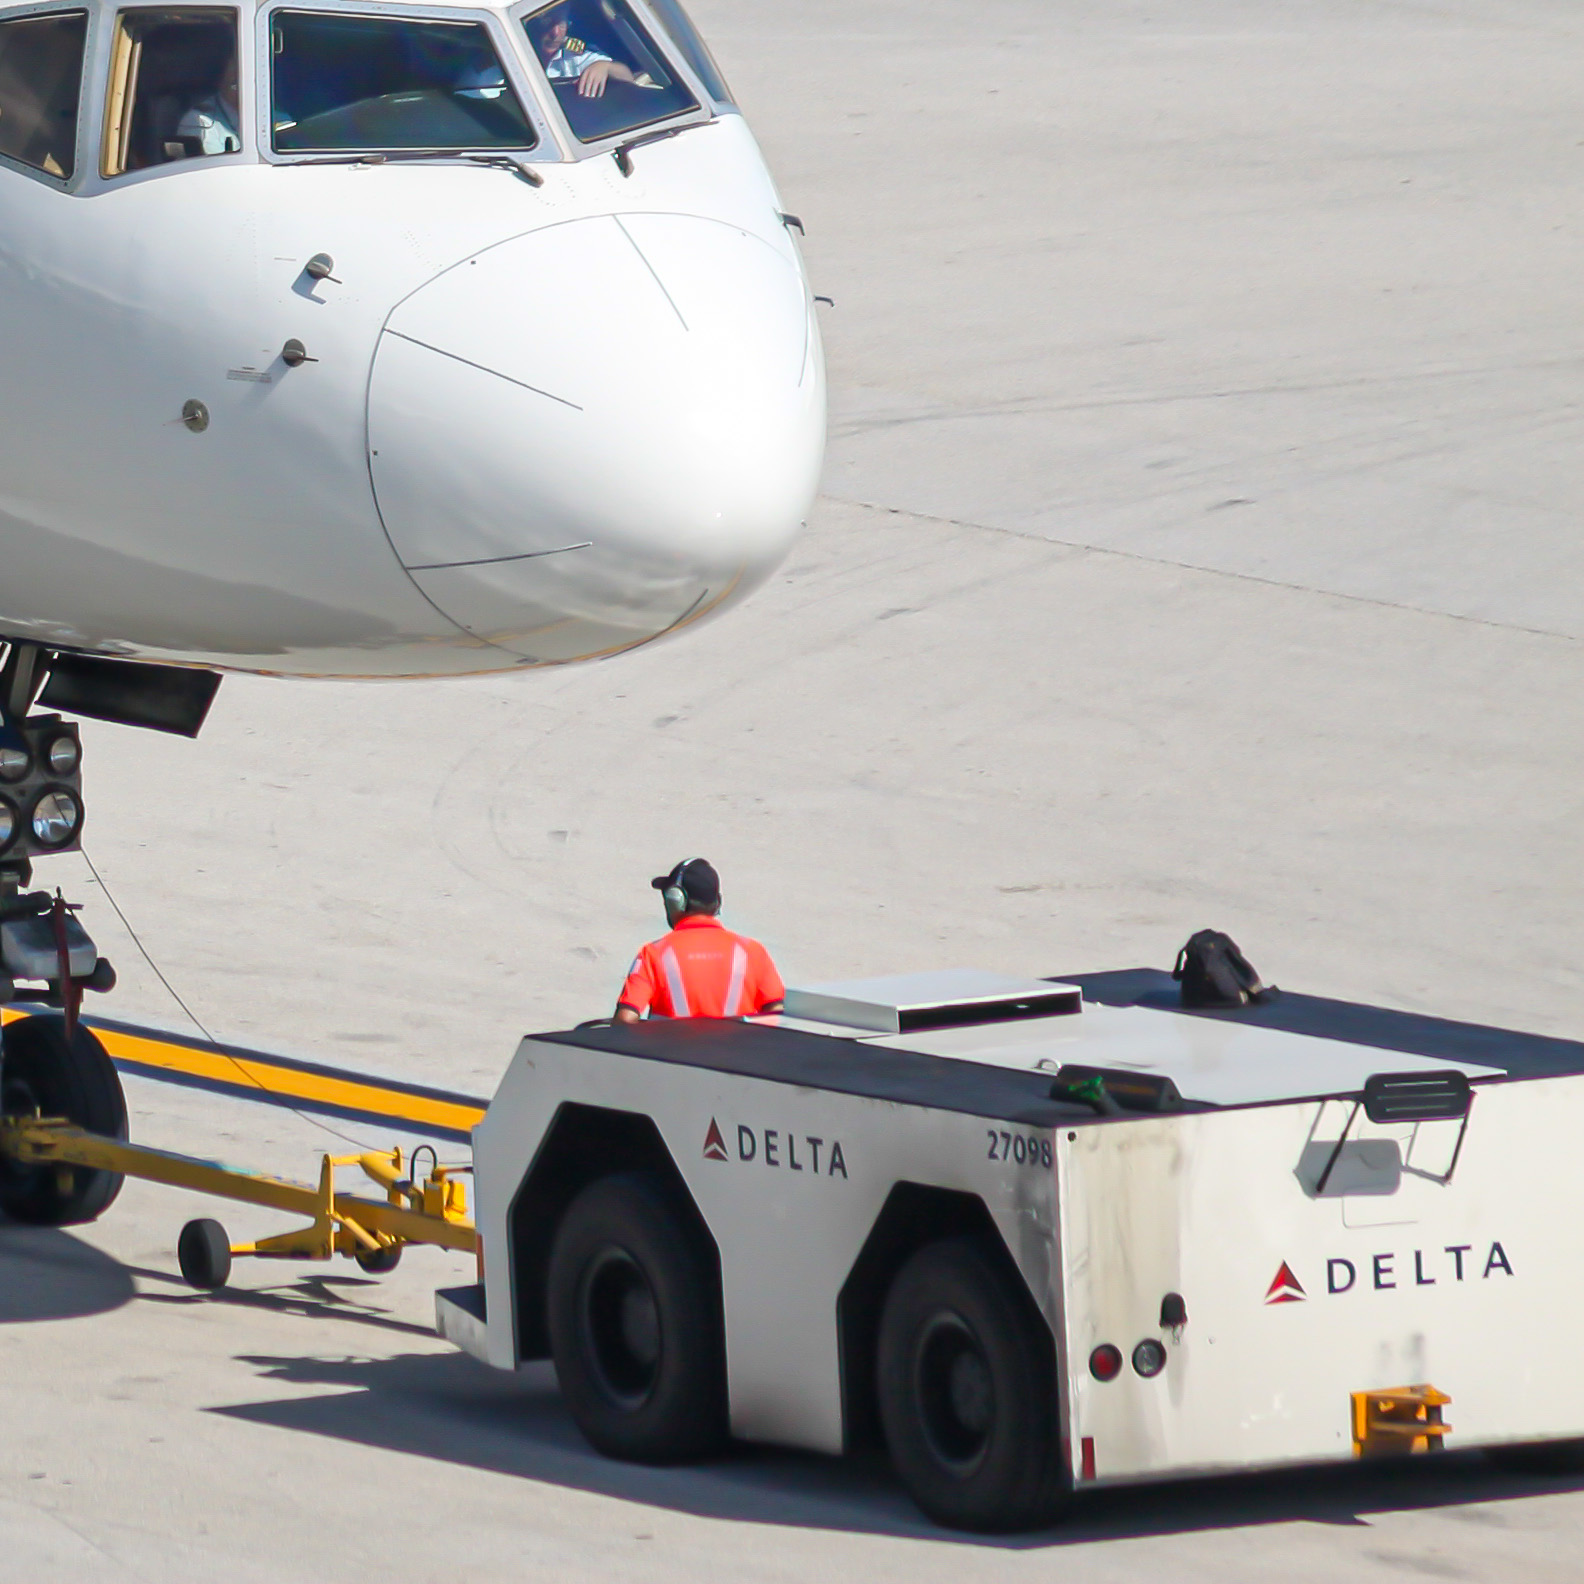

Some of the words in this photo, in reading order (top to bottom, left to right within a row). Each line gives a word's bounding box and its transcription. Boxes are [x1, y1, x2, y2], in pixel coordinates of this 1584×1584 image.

[737, 1124, 849, 1180] DELTA
[987, 1129, 1052, 1169] 27098
[1326, 1240, 1515, 1295] DELTA
